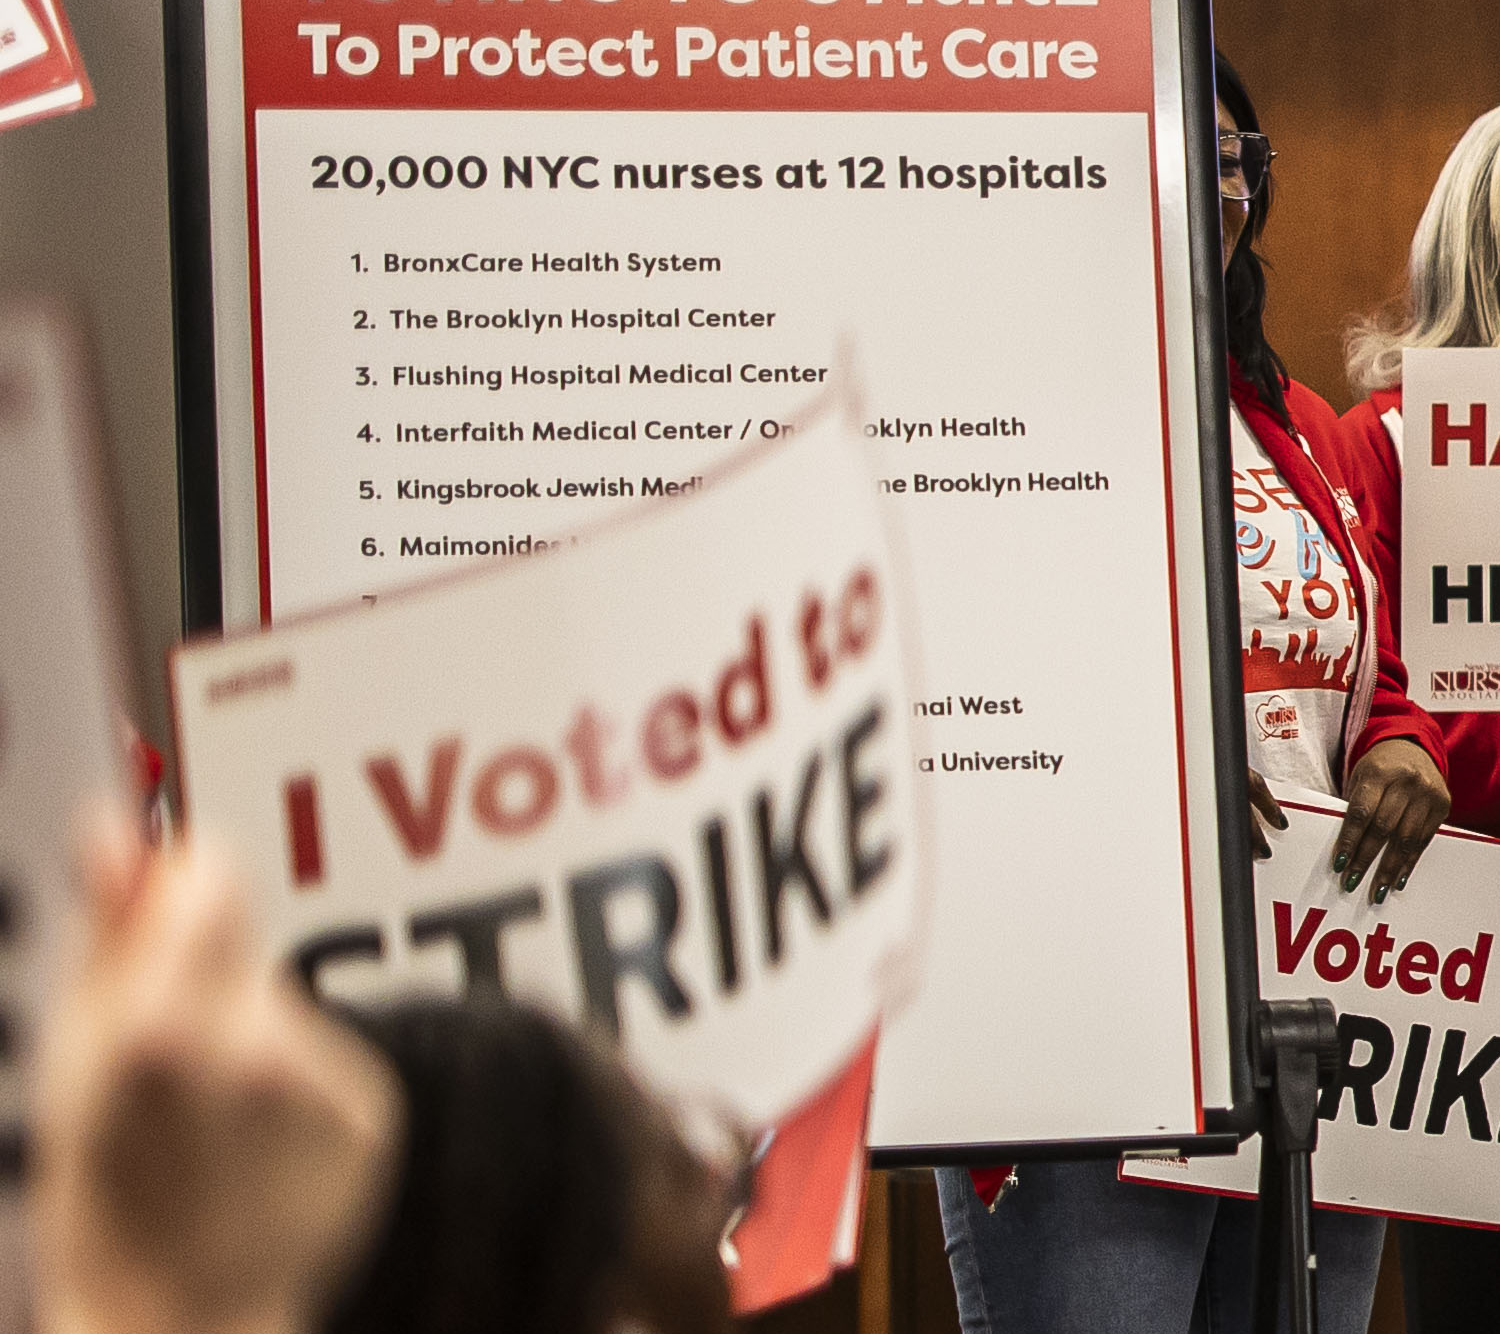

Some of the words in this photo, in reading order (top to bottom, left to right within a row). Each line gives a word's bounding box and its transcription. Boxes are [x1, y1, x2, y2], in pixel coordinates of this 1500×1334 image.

[297, 22, 380, 76] To
[398, 24, 659, 78] Protect
[675, 24, 928, 79] Patient
[941, 27, 1099, 80] Care
[311, 155, 488, 196] 20,000
[503, 155, 600, 189] NYC
[614, 164, 763, 189] nurses
[775, 159, 827, 189] at
[838, 156, 885, 189] 12
[899, 155, 1107, 199] hospitals
[384, 253, 523, 273] BronxCare
[531, 252, 619, 272] Health
[627, 252, 721, 278] System
[389, 309, 438, 329] The
[446, 308, 563, 334] Brooklyn
[571, 308, 680, 334] Hospital
[687, 308, 776, 328] Center
[393, 365, 502, 391] Flushing
[511, 364, 621, 391] Hospital
[629, 363, 732, 384] Medical
[739, 363, 828, 383] Center
[396, 421, 524, 443] Interfaith
[532, 420, 637, 441] Medical
[644, 420, 733, 440] Center
[941, 416, 1026, 437] Health
[397, 477, 541, 505] Kingsbrook
[546, 476, 634, 498] Jewish
[913, 472, 1021, 498] Brooklyn
[1028, 471, 1109, 491] Health
[959, 696, 1023, 715] West
[283, 775, 328, 891] I
[365, 613, 772, 863] Voted
[801, 565, 882, 693] to
[941, 750, 1064, 775] University
[288, 699, 896, 1039] STRIKE
[1272, 900, 1494, 1004] Voted
